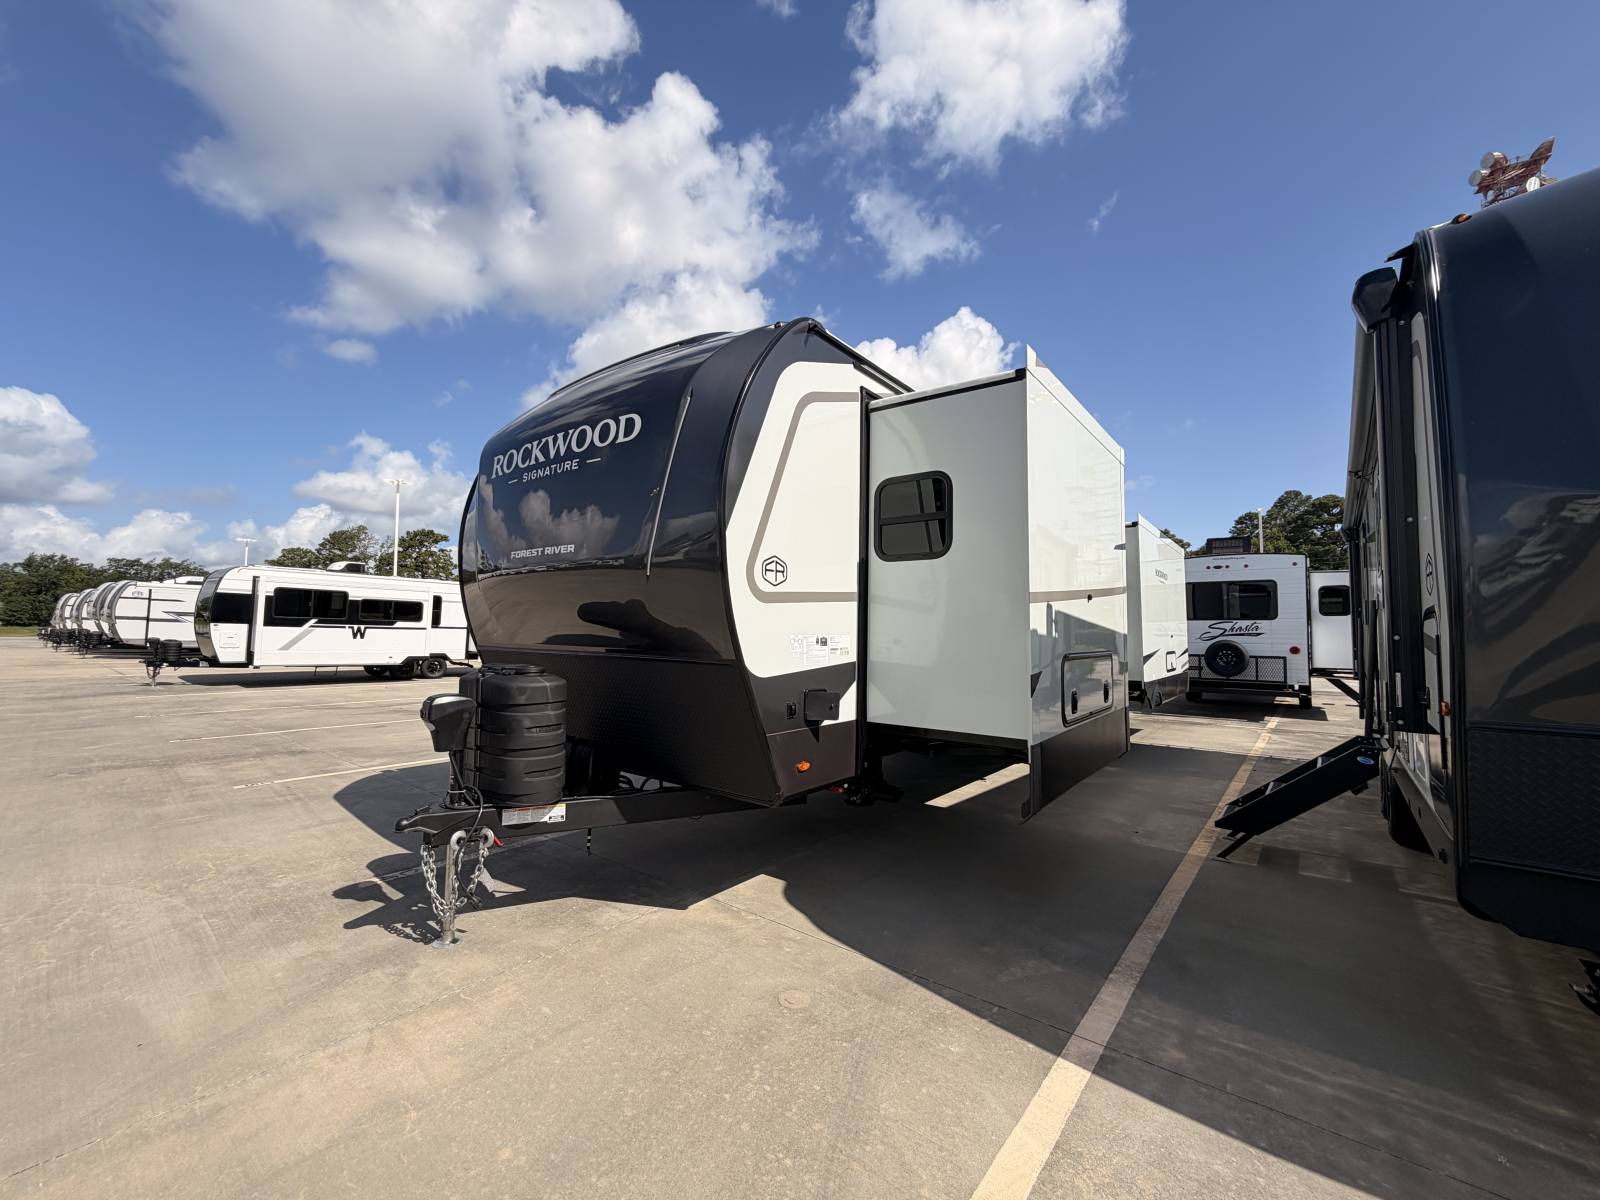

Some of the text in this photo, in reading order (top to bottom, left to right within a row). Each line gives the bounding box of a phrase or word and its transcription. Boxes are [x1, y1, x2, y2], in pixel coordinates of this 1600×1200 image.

[491, 413, 642, 479] ROCKWOOD
[522, 458, 580, 482] SIGNATURE
[510, 544, 575, 559] FOREST RIVER
[350, 625, 367, 640] W
[1196, 620, 1264, 641] Shasta
